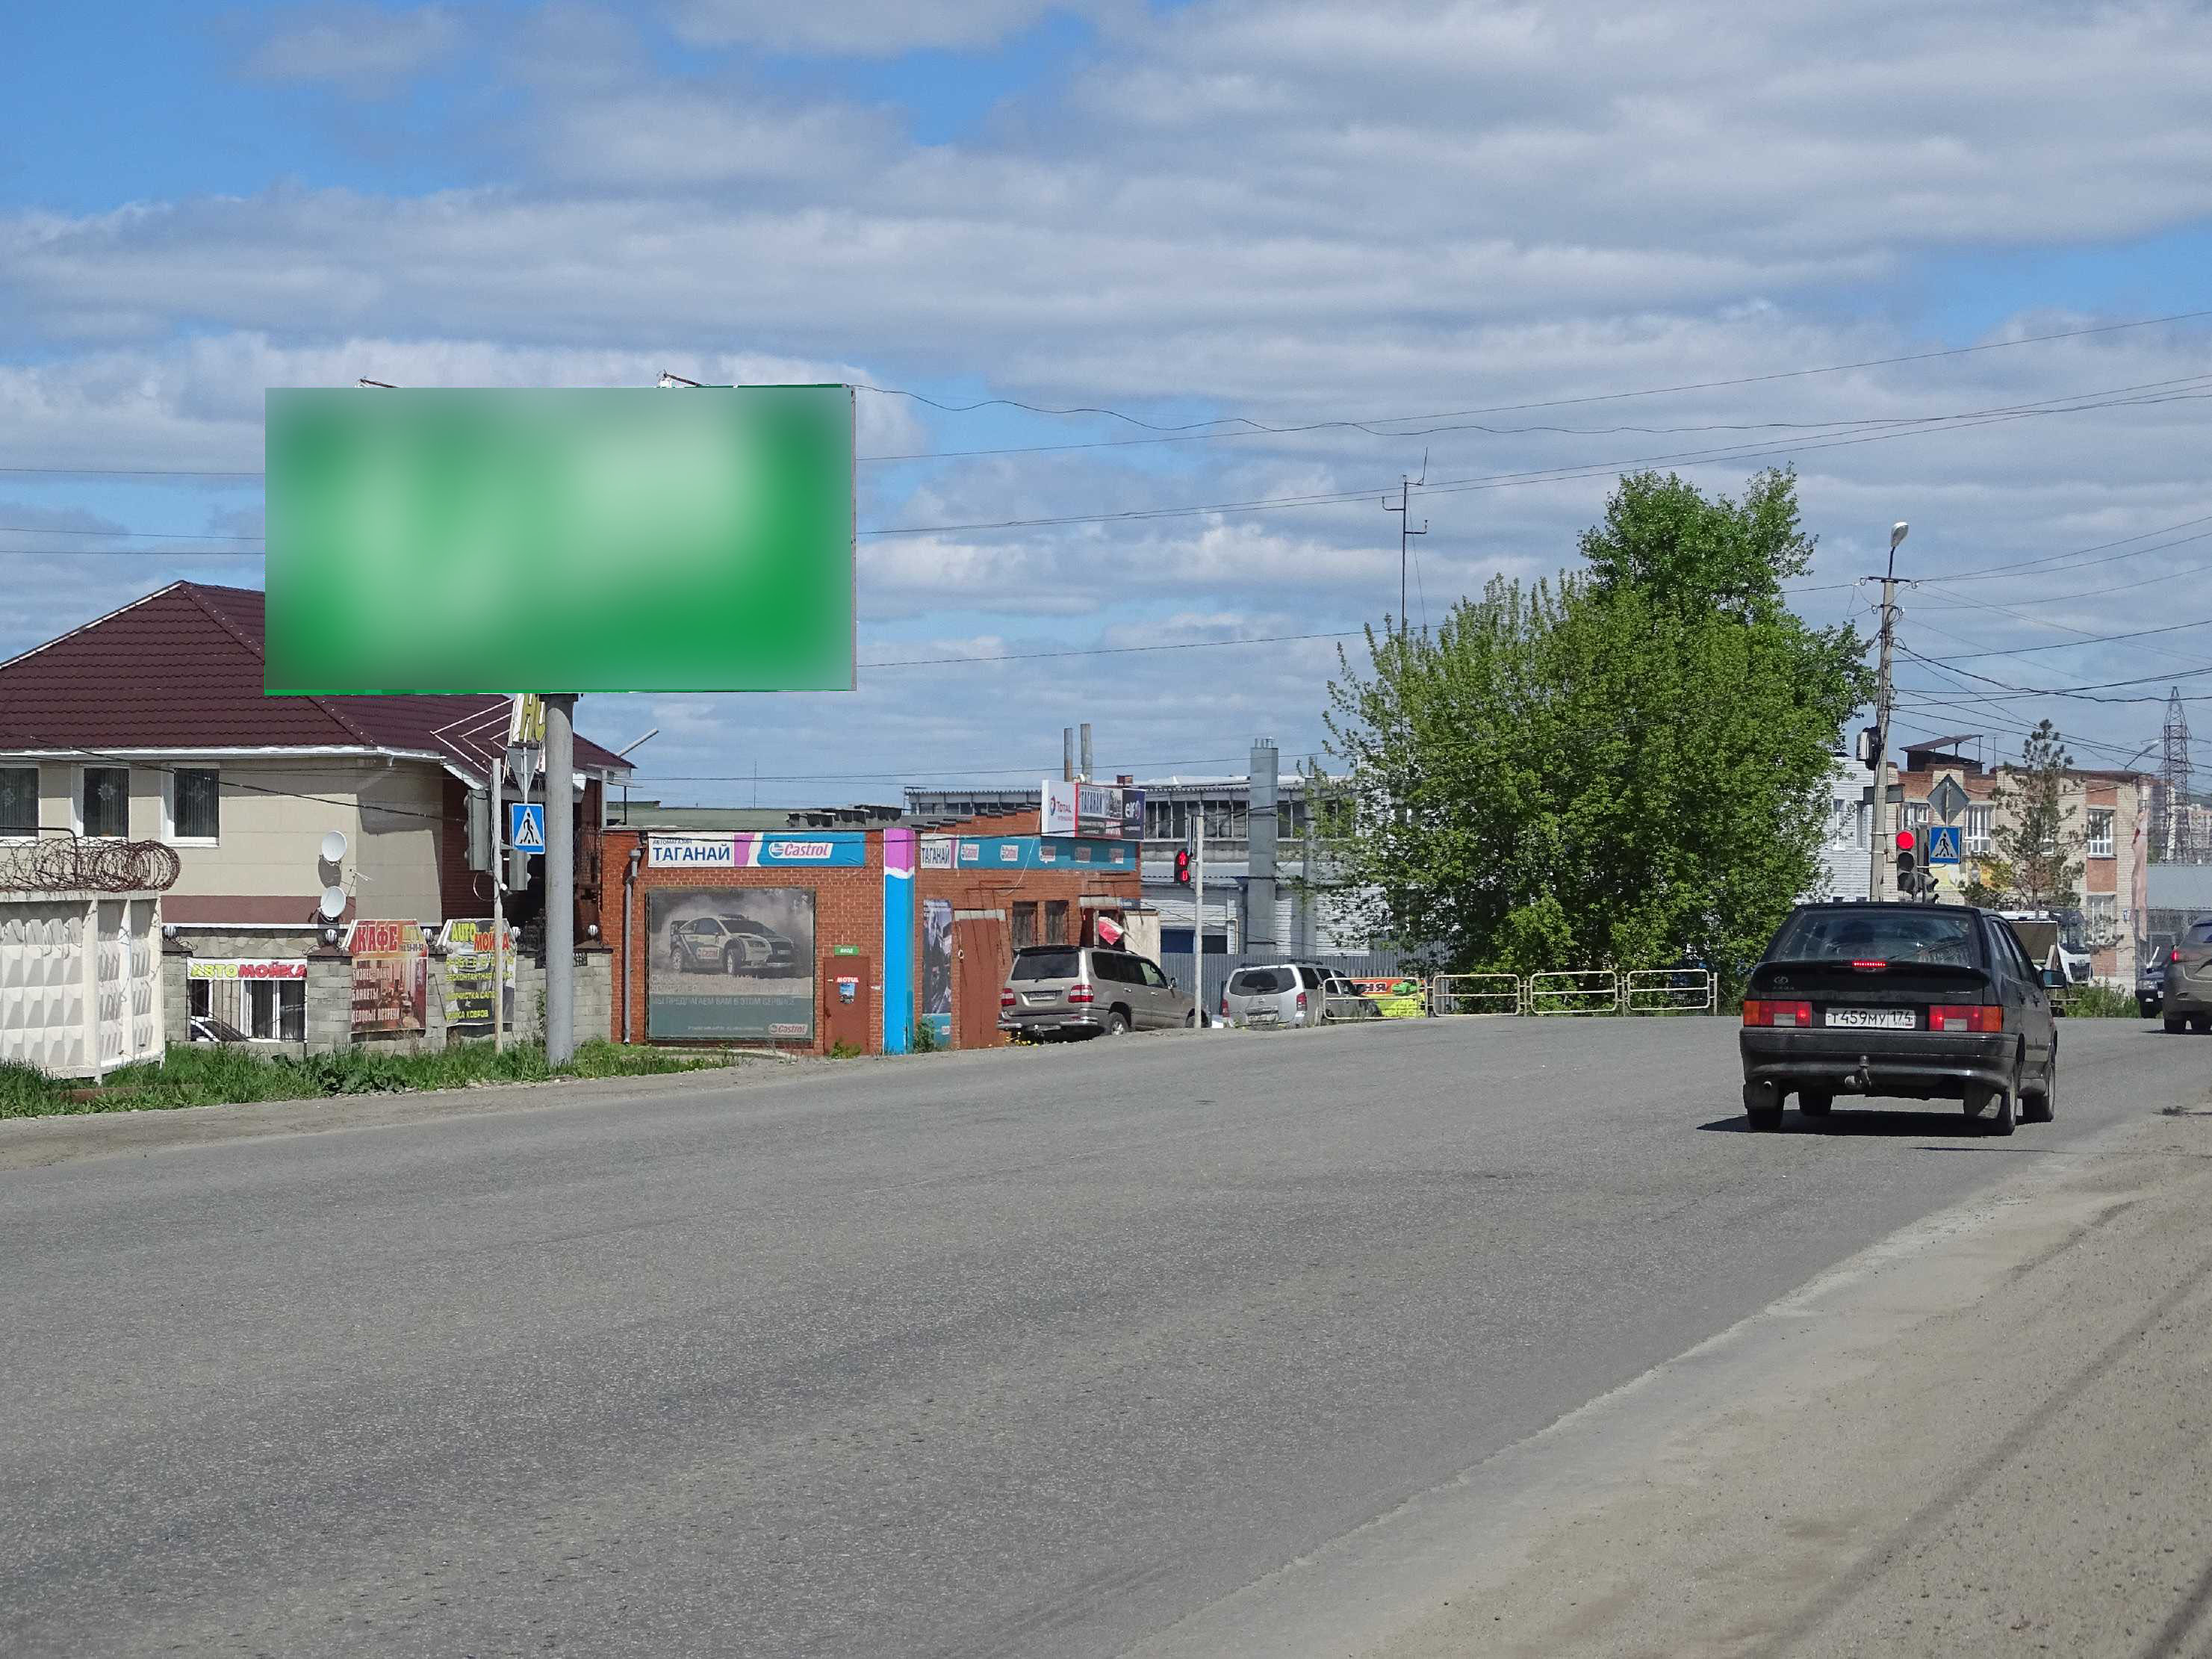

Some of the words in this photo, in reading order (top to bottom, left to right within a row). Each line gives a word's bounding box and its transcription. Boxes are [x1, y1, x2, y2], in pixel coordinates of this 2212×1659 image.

[1056, 801, 1072, 813] TOTAL
[1125, 802, 1135, 819] elf
[653, 843, 730, 861] ТАГАНАЙ
[784, 842, 829, 857] Castrol
[922, 844, 950, 864] ТАГАНАЙ
[356, 925, 398, 952] КАФЕ
[473, 926, 509, 951] МОЙА
[190, 961, 307, 978] АВТОМОЙКА
[352, 987, 379, 1001] БАНКЕТЫ
[352, 1009, 376, 1024] ДЕЛОВЫЕ
[467, 1010, 489, 1020] КОВРОВ
[1832, 1011, 1886, 1025] Т459МУ
[1891, 1011, 1911, 1023] 174
[778, 1025, 806, 1034] Castrol
